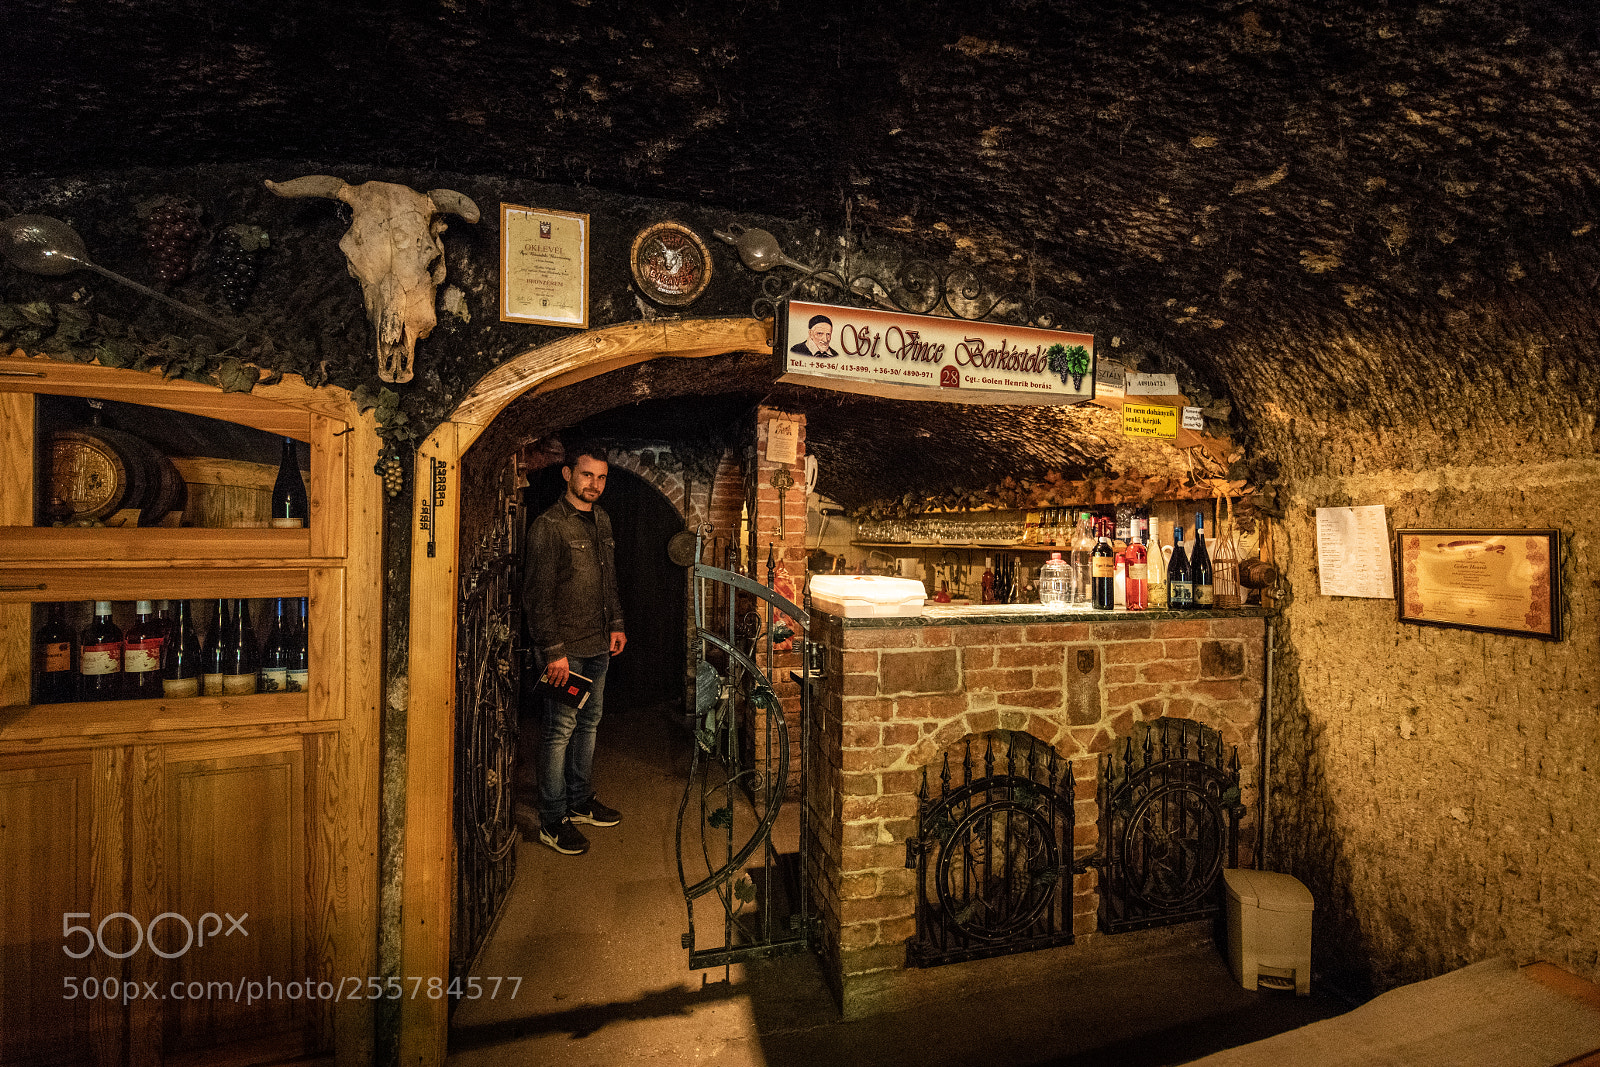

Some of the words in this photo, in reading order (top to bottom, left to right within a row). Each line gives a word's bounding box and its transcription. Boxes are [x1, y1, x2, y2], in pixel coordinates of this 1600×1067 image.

[524, 243, 565, 254] OKLEVÉL
[840, 323, 881, 359] St.
[884, 325, 946, 364] Vince
[954, 335, 1049, 374] Borkóstoló
[790, 358, 807, 368] Tel.:
[809, 361, 839, 371] +36-36/
[840, 364, 871, 374] 413-899,
[873, 367, 902, 377] +36-30/
[903, 370, 934, 379] 4890-971
[941, 369, 959, 385] 28
[981, 377, 1003, 386] Golen
[1004, 379, 1029, 388] Henrik
[1030, 381, 1053, 390] borász
[1146, 408, 1176, 418] dohányzik
[1142, 417, 1162, 426] kérjük
[1141, 427, 1157, 435] tegye!
